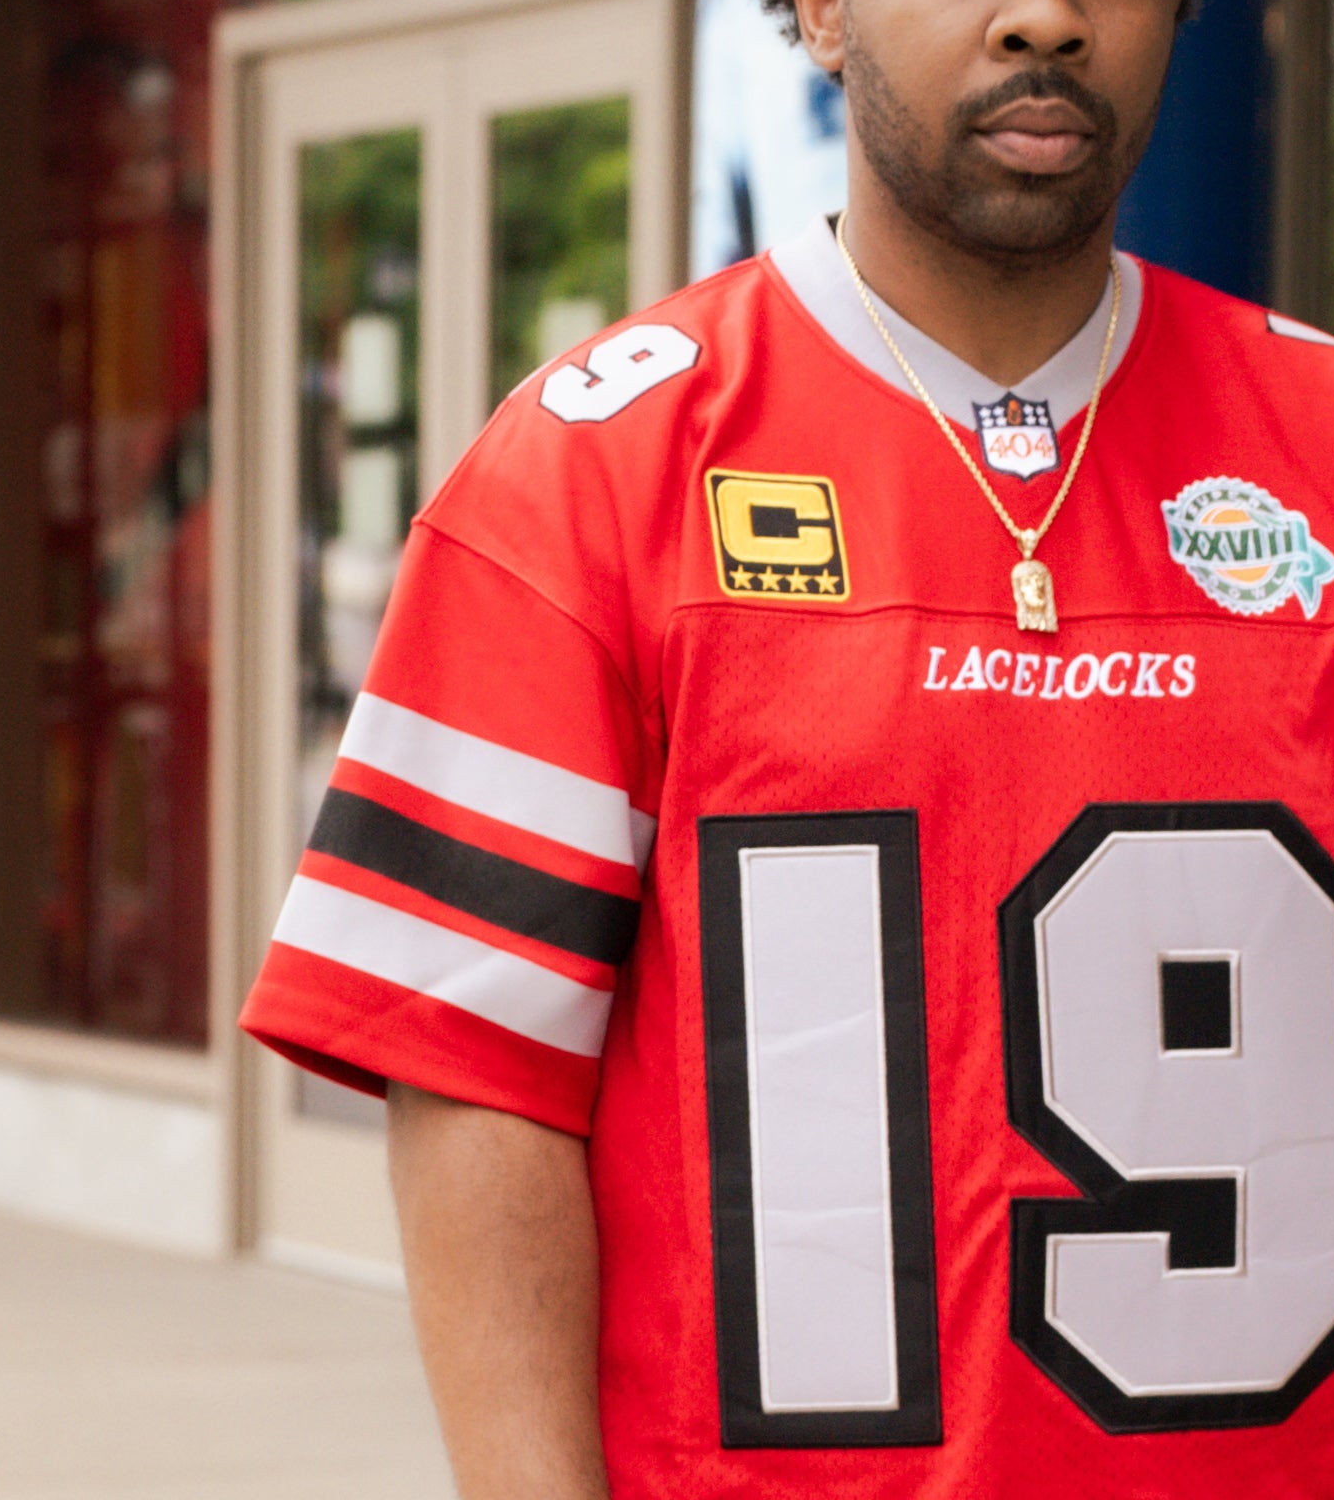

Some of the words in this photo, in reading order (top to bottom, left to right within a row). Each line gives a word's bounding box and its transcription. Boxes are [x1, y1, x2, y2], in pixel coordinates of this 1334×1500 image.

[988, 431, 1054, 460] 404
[715, 478, 835, 566] C
[1183, 523, 1294, 563] XXVIII
[923, 645, 1196, 701] LACELOCKS
